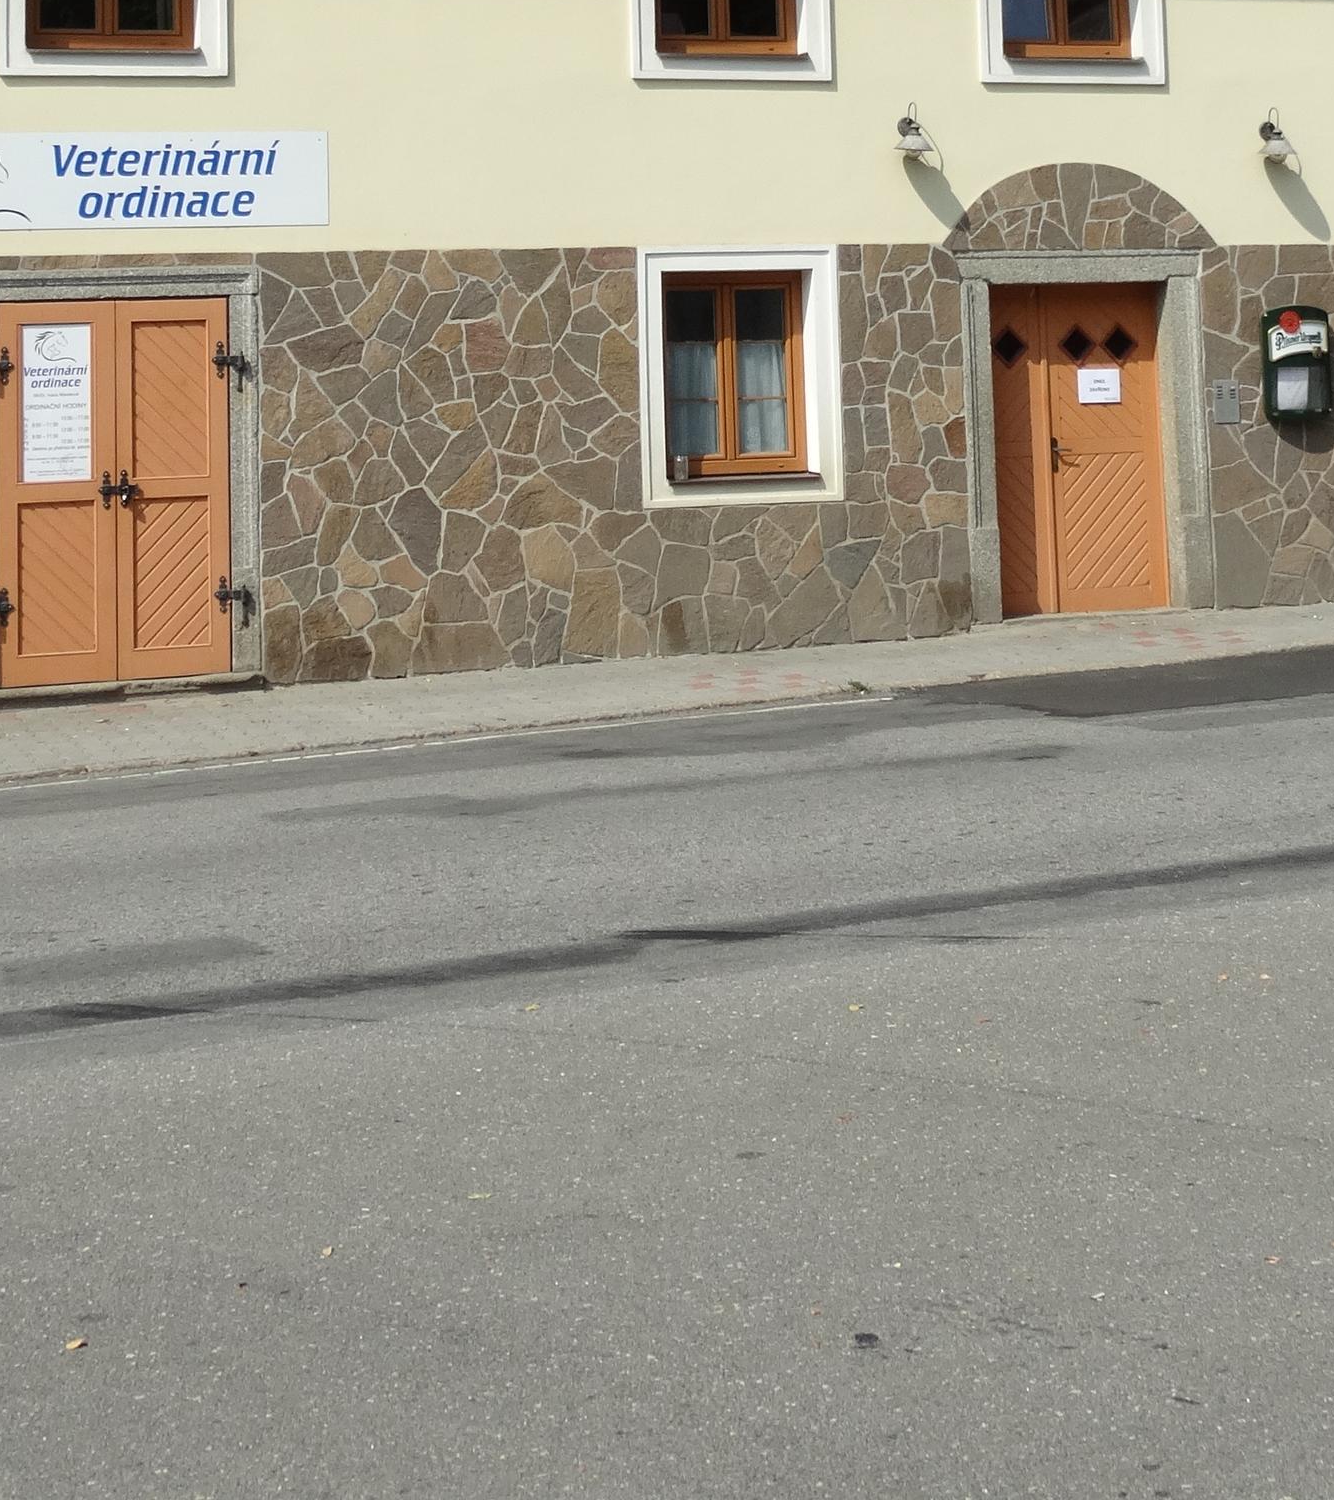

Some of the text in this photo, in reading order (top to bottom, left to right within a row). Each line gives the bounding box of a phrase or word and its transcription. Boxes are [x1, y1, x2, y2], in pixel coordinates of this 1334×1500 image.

[52, 140, 281, 178] Veterinární
[78, 185, 256, 220] ordinace
[23, 364, 88, 377] Veterinární
[30, 378, 82, 389] ordinace
